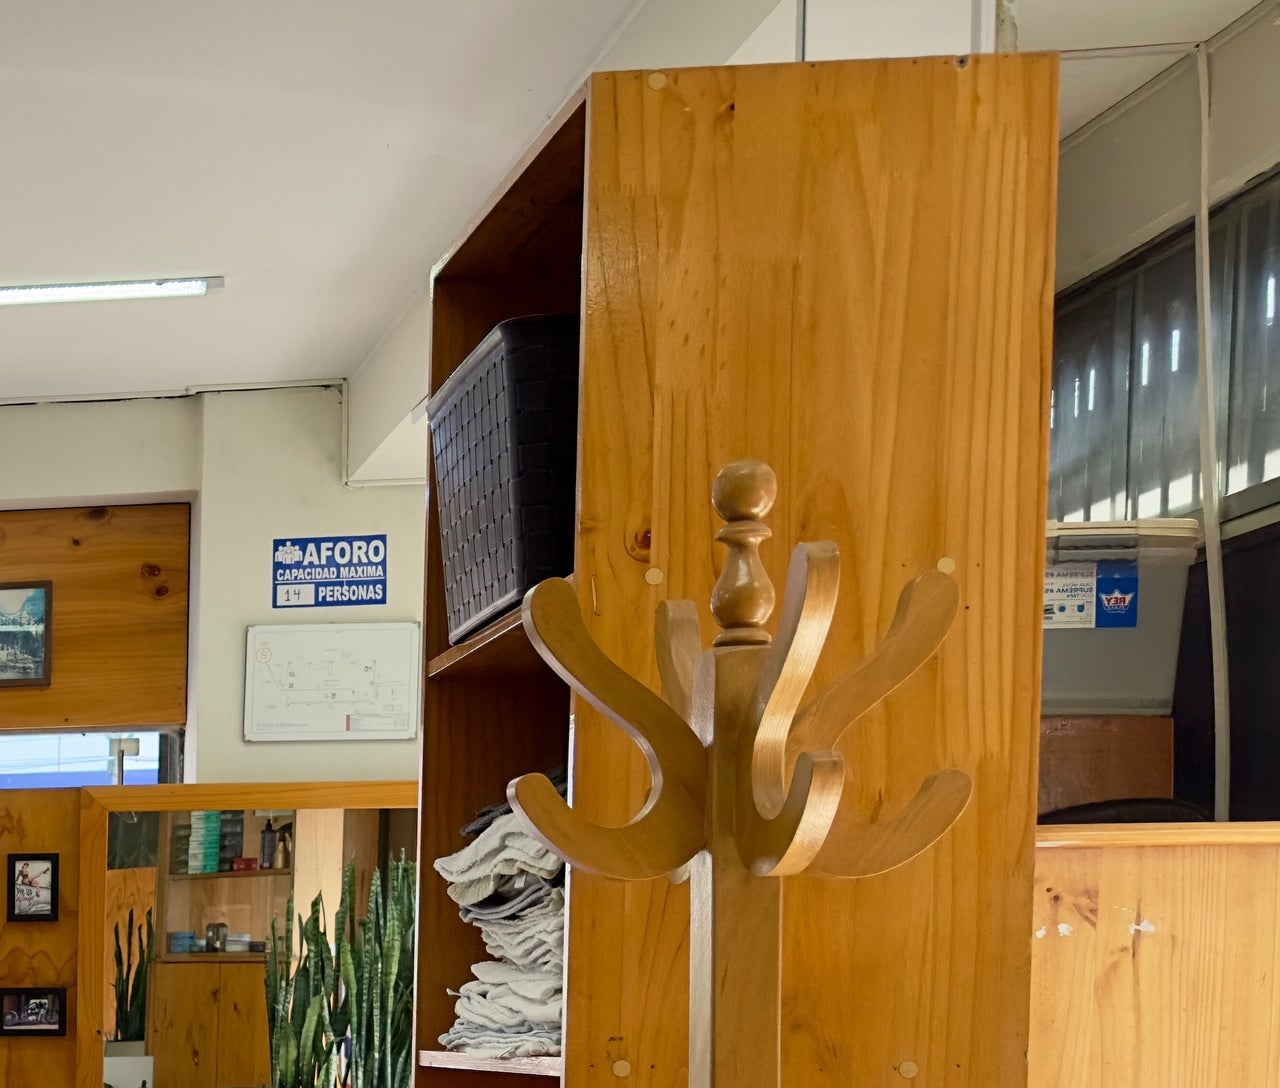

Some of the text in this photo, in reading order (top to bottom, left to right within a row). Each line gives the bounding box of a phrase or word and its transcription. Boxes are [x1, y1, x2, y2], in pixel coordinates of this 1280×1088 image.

[302, 539, 386, 566] AFORO
[276, 565, 384, 581] CAPACIDAD MAXIMA
[284, 588, 301, 602] 14
[318, 583, 384, 602] PERSONAS
